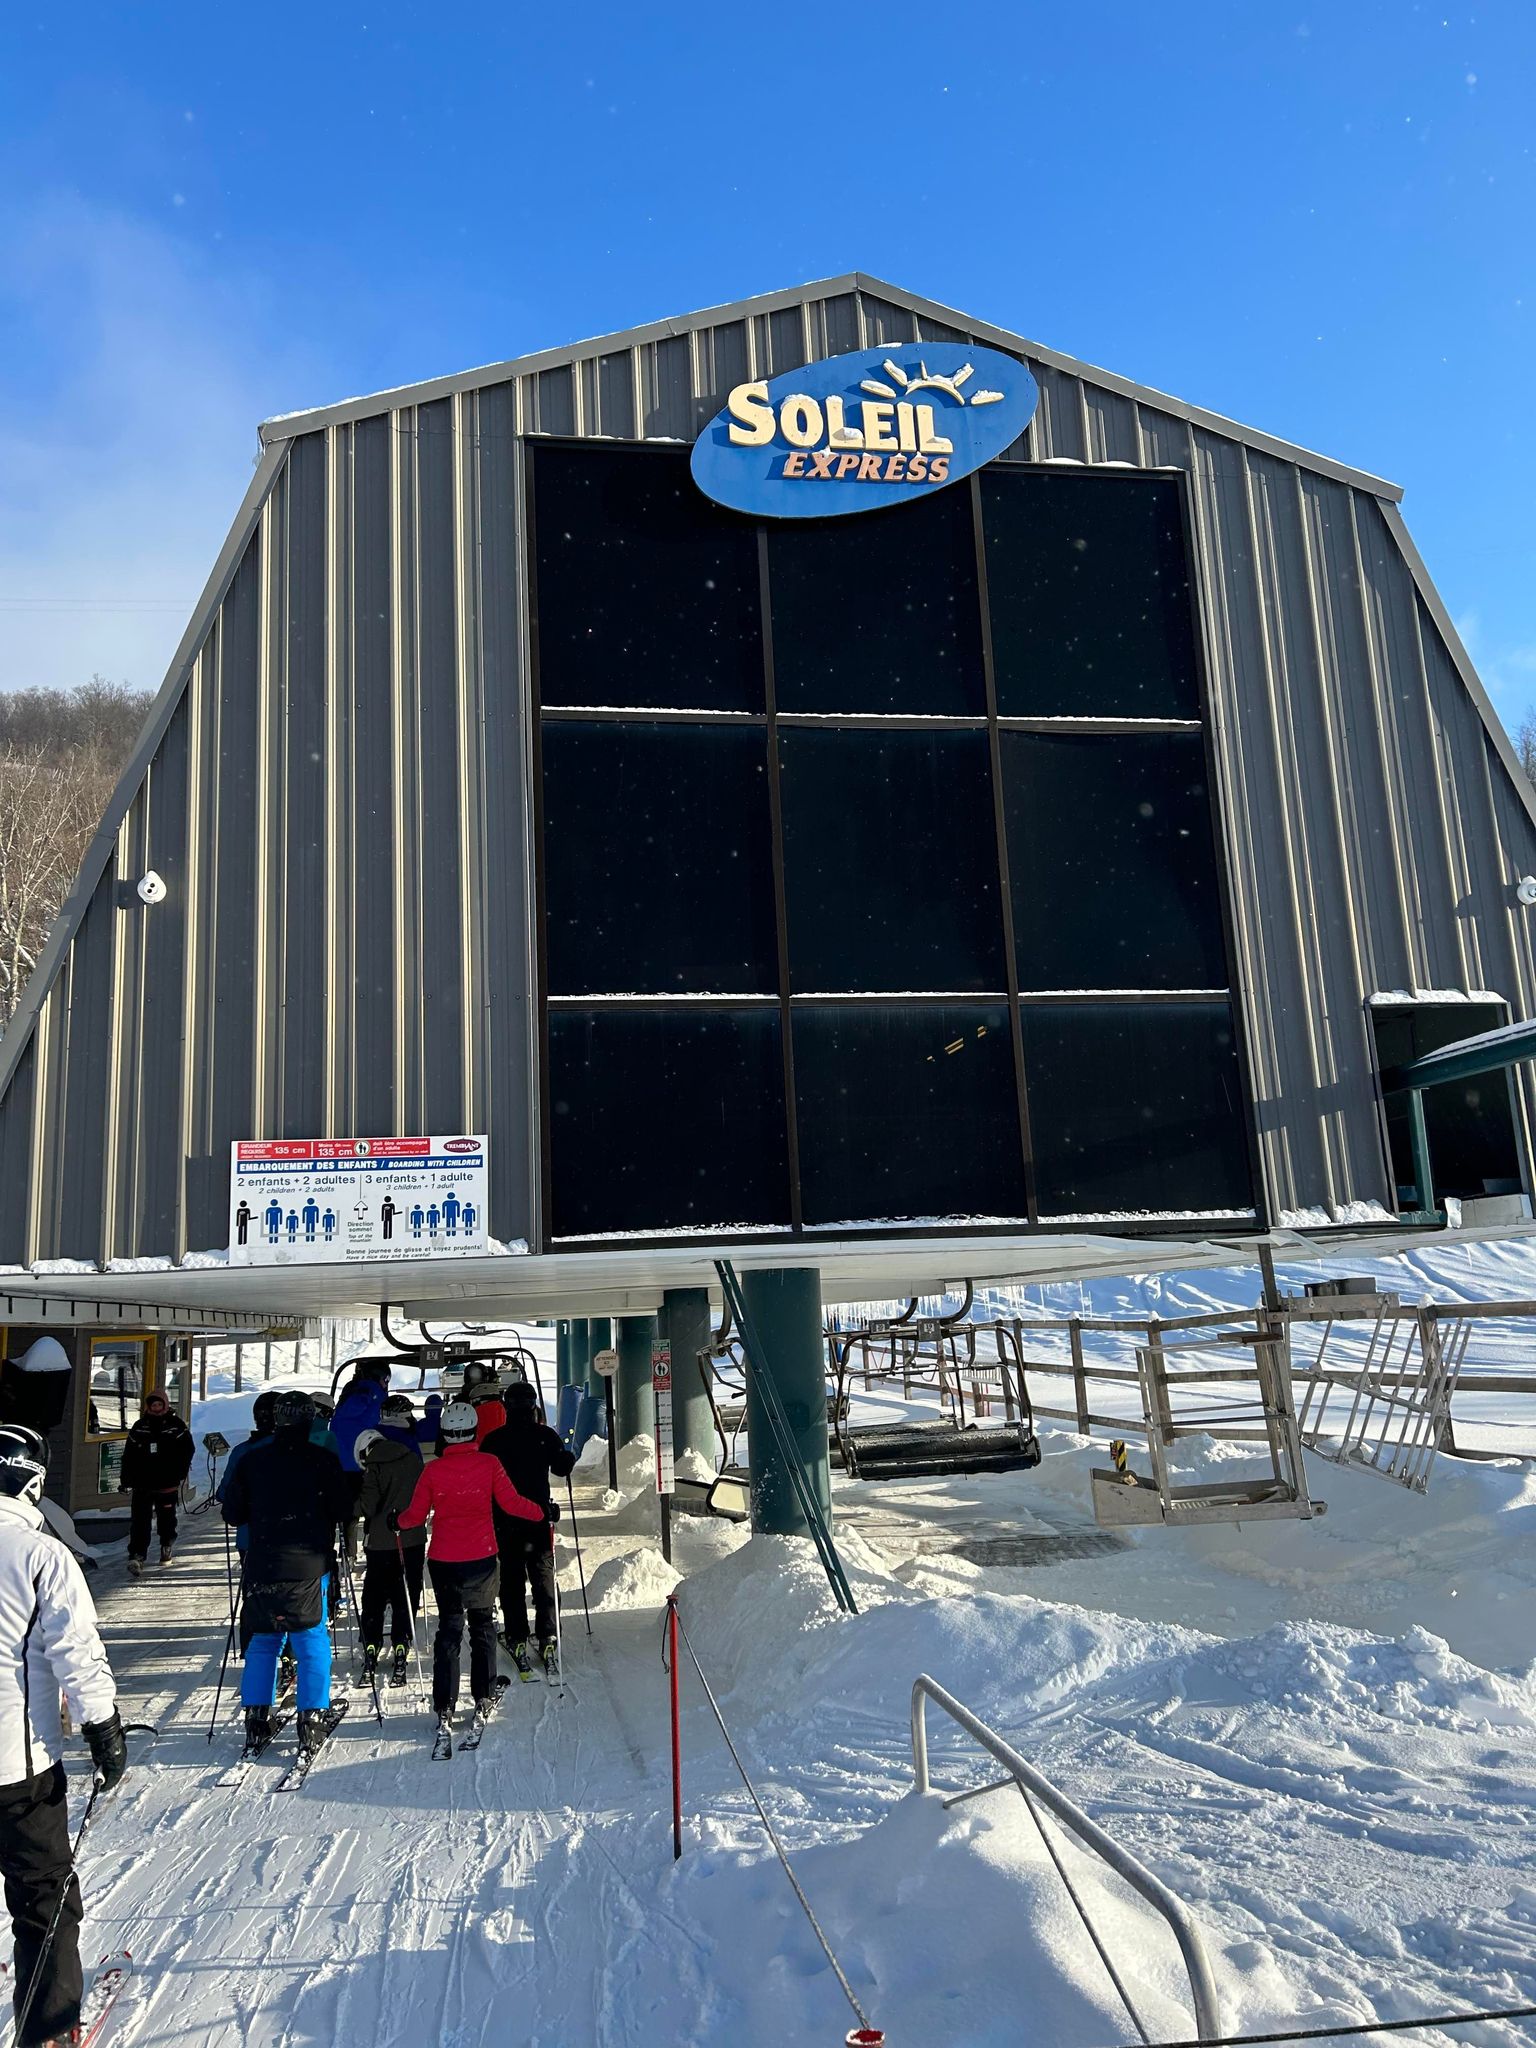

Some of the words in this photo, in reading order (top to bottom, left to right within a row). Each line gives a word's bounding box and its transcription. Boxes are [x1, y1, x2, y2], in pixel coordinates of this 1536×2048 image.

[728, 380, 954, 454] SOLEIL
[782, 452, 949, 484] EXPRESS
[318, 1148, 334, 1156] 135
[239, 1162, 314, 1171] EMBARQUEMENT
[317, 1161, 334, 1170] DES
[338, 1160, 377, 1169] ENFANTS
[388, 1160, 424, 1168] BOARDING
[446, 1158, 481, 1166] CHILDREN
[237, 1177, 245, 1187] 2
[248, 1177, 291, 1186] enfants
[303, 1176, 310, 1185] 2
[315, 1175, 356, 1185] adultes
[365, 1175, 372, 1183] 3
[376, 1174, 417, 1183] enfants
[440, 1172, 473, 1181] adulte
